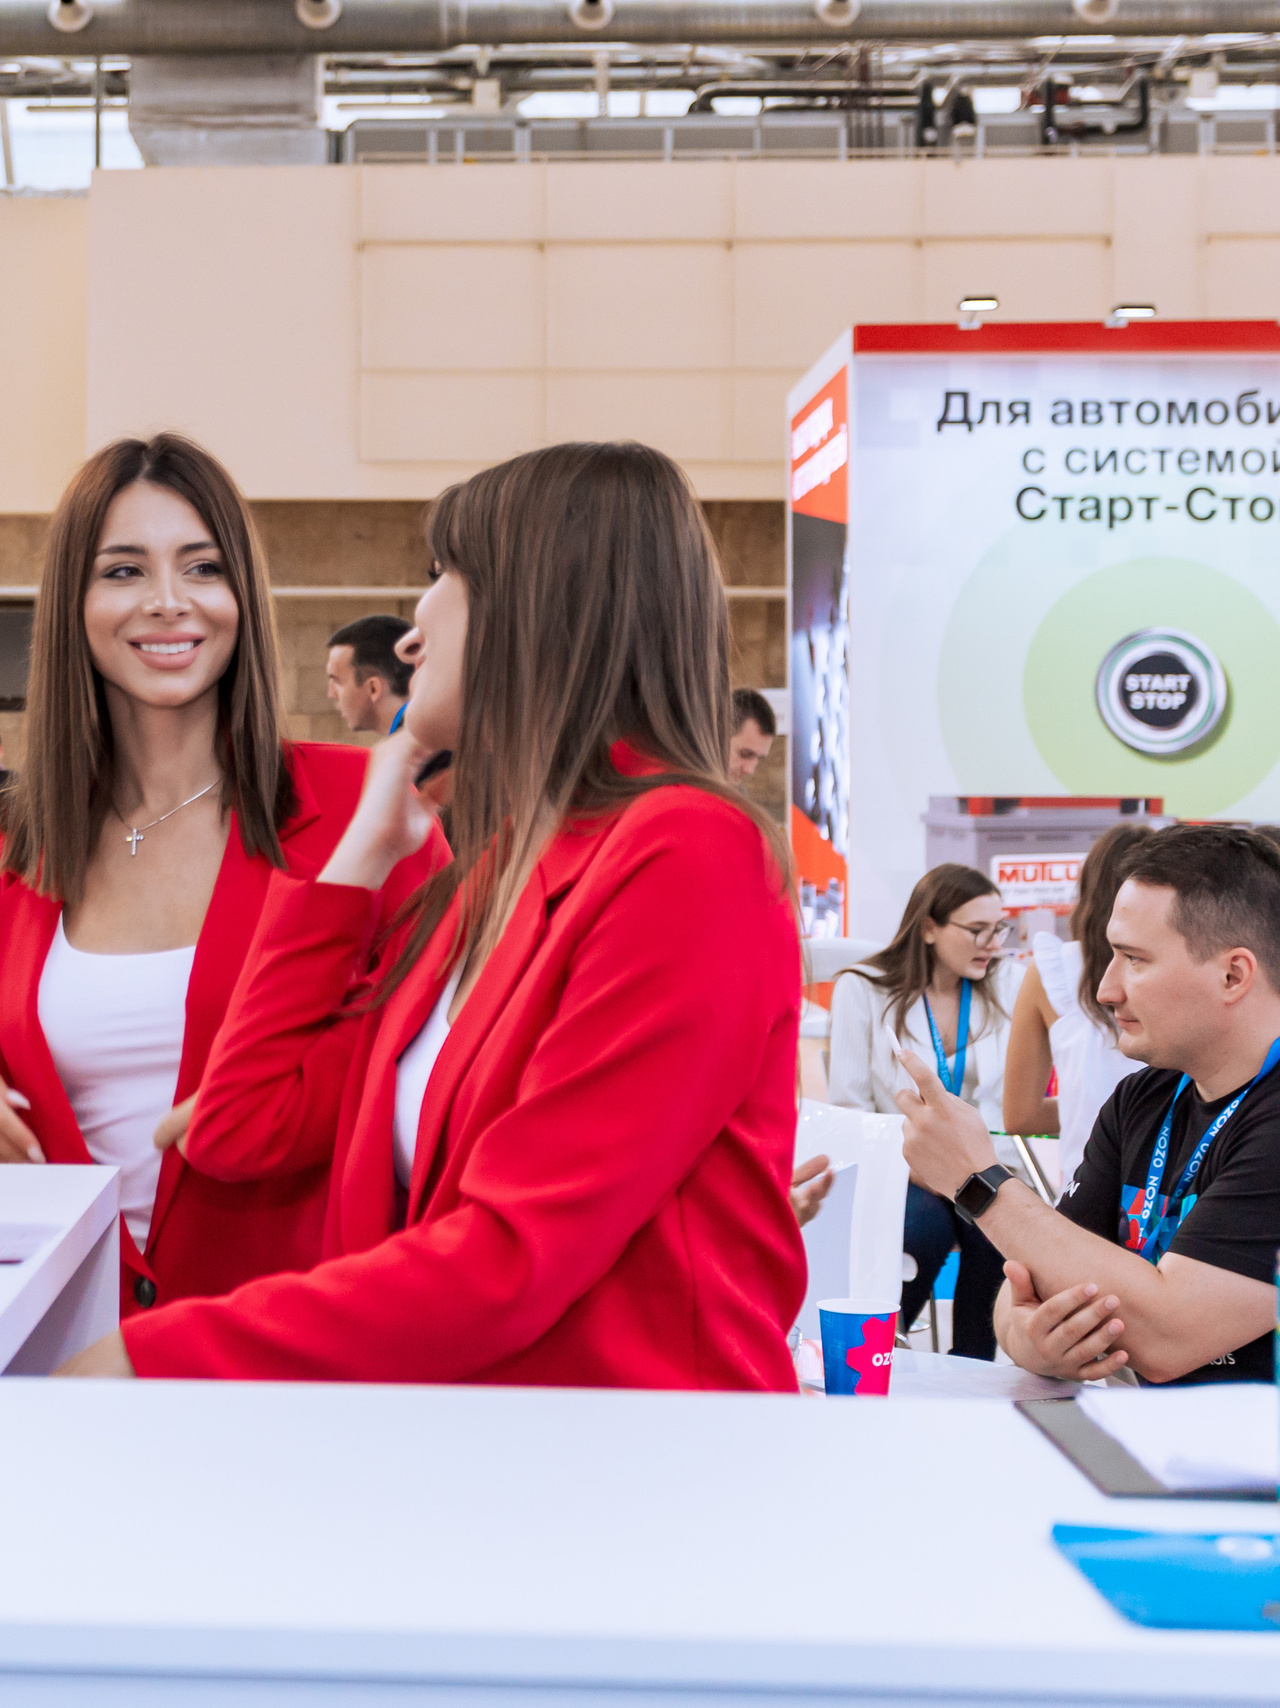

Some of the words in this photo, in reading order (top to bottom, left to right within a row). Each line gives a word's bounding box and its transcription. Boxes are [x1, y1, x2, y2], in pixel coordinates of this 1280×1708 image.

[937, 391, 1031, 432] Для
[1023, 449, 1045, 475] с
[1125, 673, 1192, 692] START
[1130, 691, 1187, 710] STOP
[1210, 1099, 1241, 1138] OZON
[1153, 1126, 1170, 1169] OZON
[1142, 1176, 1160, 1219] OZON
[871, 1352, 894, 1367] OZ
